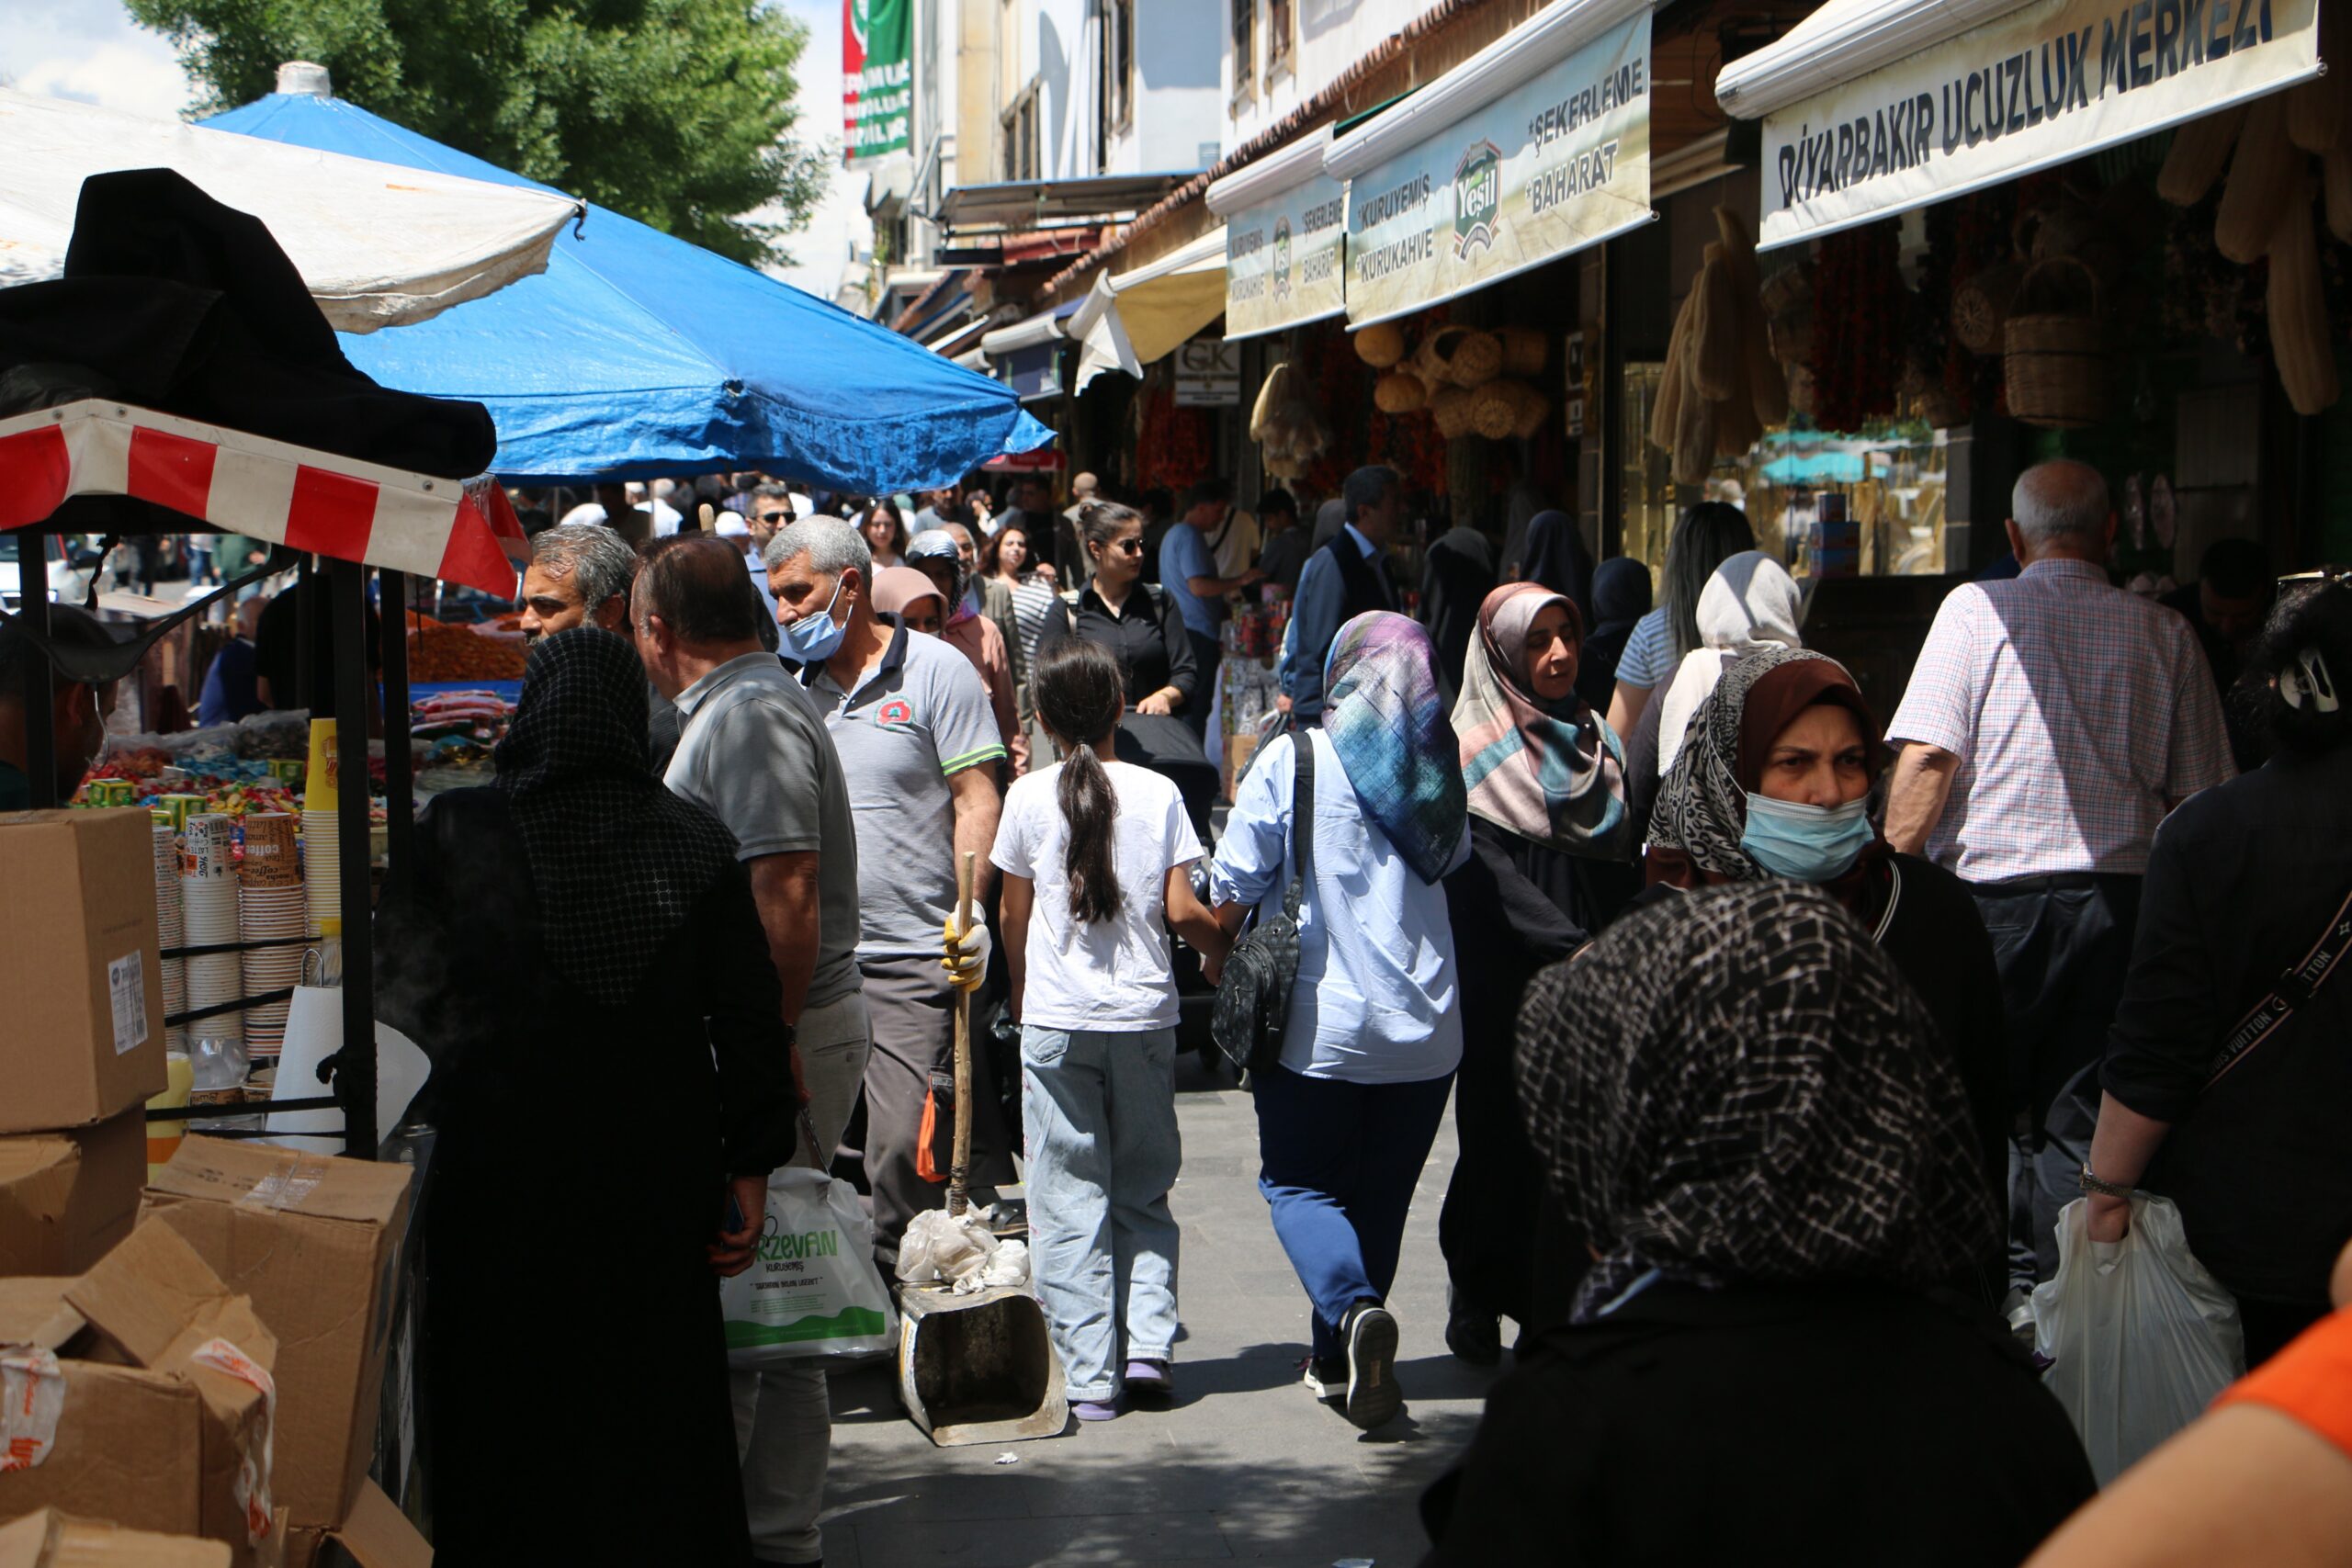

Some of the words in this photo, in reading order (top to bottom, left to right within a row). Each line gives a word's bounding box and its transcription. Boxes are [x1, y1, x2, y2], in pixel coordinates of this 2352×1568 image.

[1779, 93, 1935, 209] DİYARBAKIR
[1941, 25, 2093, 157] UCUZLUK
[1457, 168, 1497, 220] Yeşil
[2301, 950, 2332, 984] TTON
